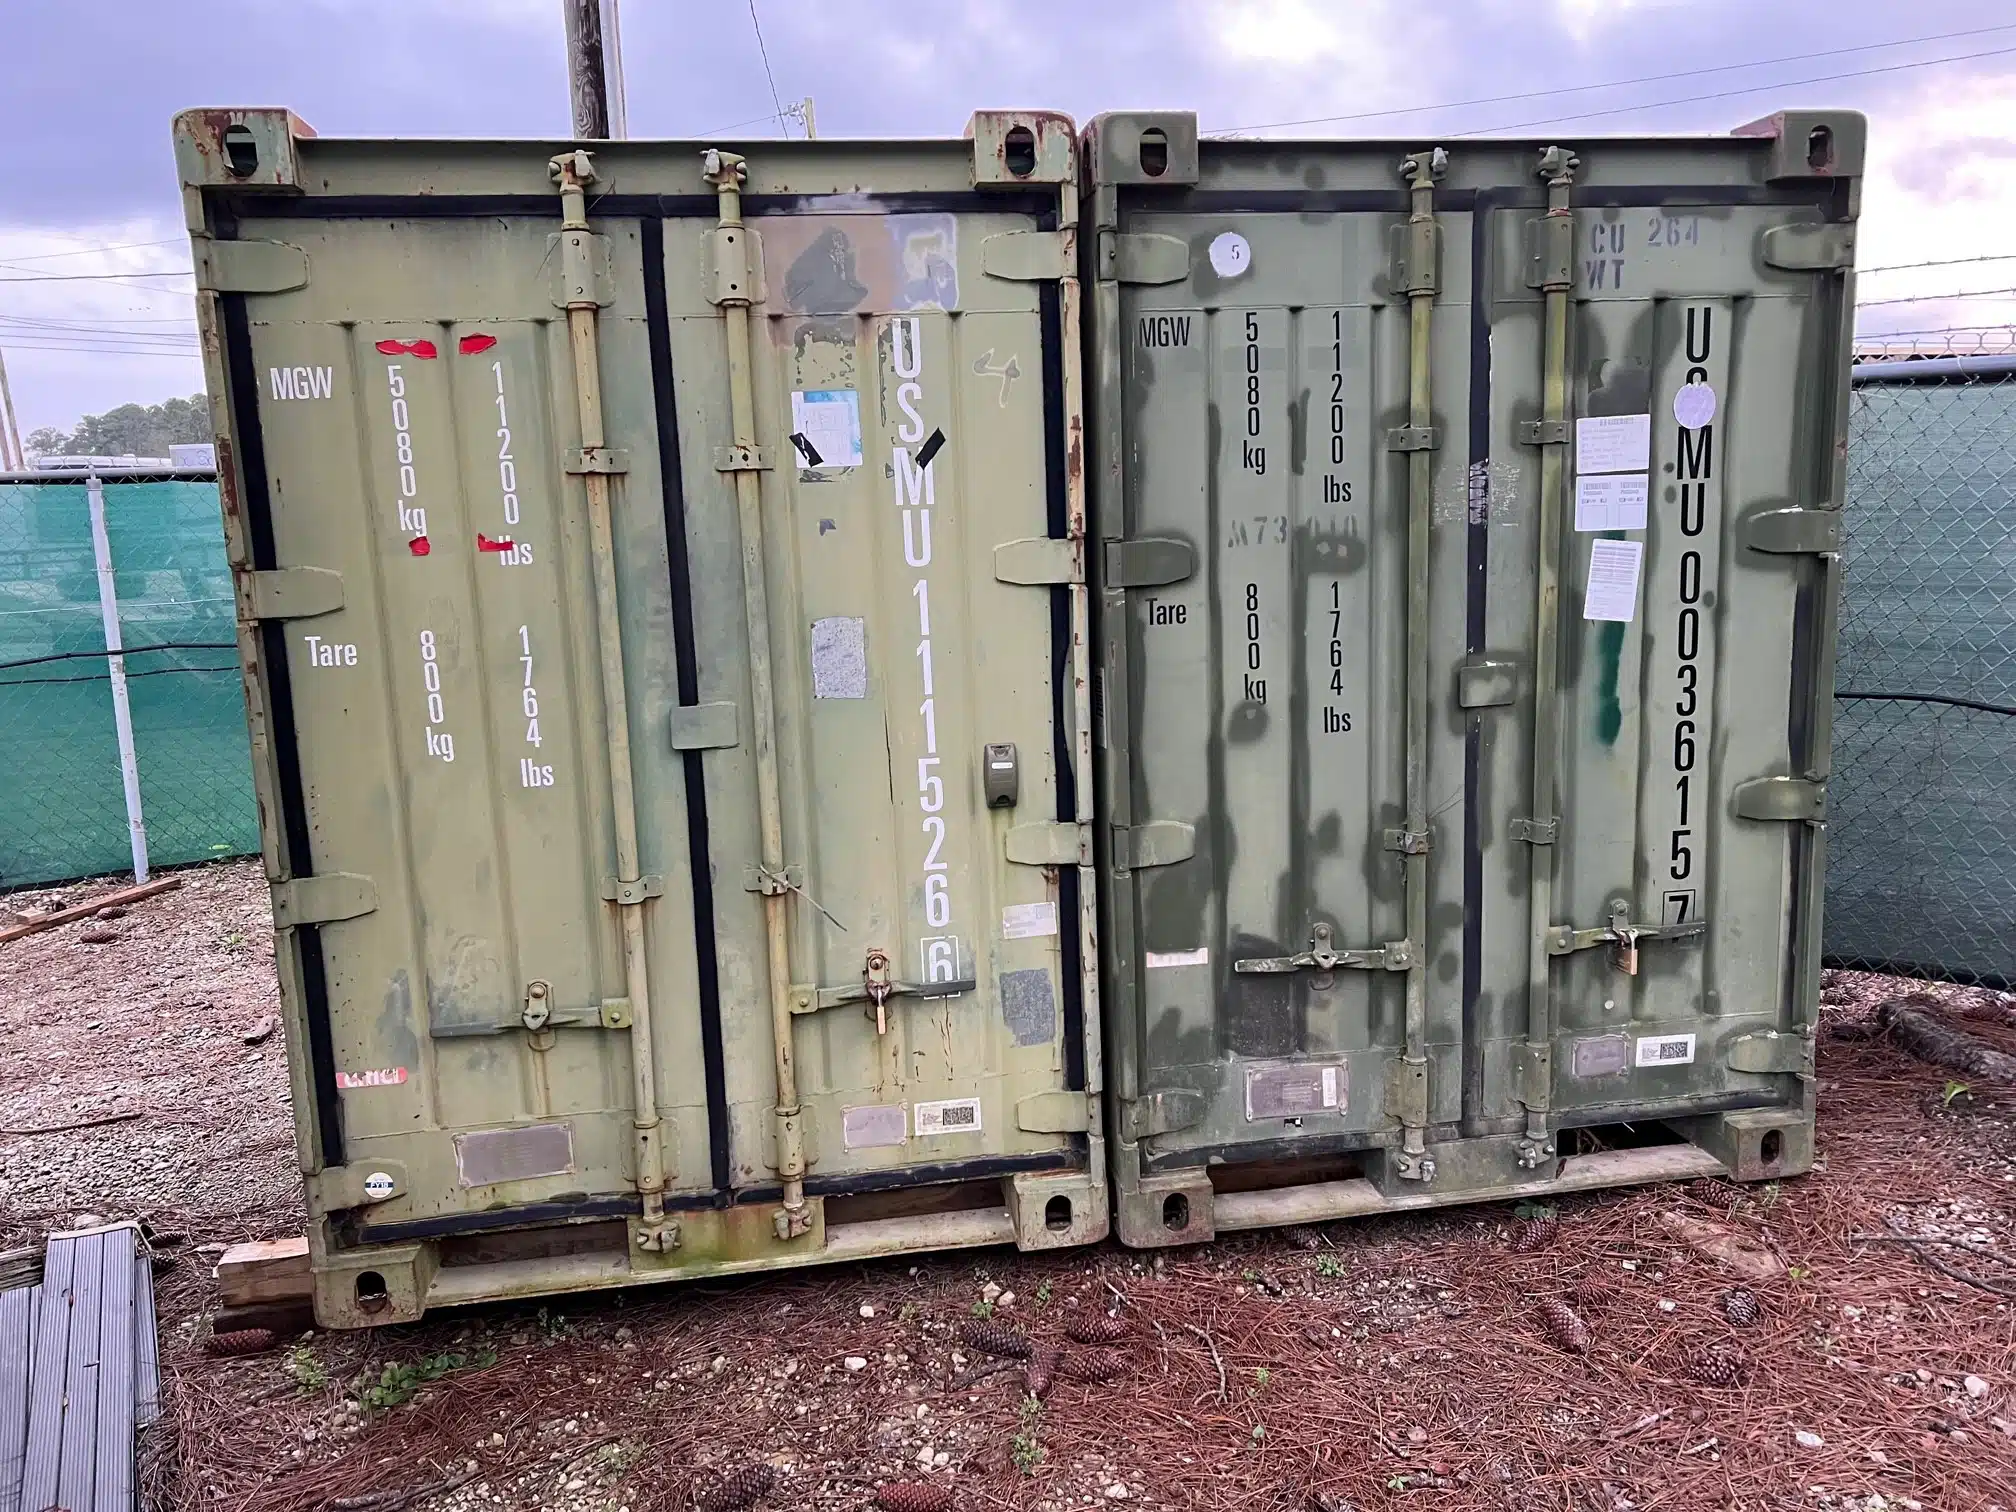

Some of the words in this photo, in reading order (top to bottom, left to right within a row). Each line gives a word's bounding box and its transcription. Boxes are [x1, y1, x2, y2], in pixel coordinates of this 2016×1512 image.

[1231, 244, 1240, 260] 5
[1591, 223, 1625, 254] CU
[1647, 217, 1699, 247] 264
[1585, 259, 1625, 290] WT
[1139, 316, 1190, 348] MGW
[269, 366, 333, 400] MGW
[1245, 311, 1260, 437] 5080
[1331, 310, 1344, 465] 11200
[387, 364, 417, 497] 5080
[491, 361, 520, 525] 11200
[1243, 439, 1266, 476] kg
[1324, 474, 1352, 504] lbs
[397, 499, 428, 538] kg
[498, 535, 534, 566] lbs
[1147, 597, 1188, 626] Tare
[1246, 583, 1261, 670] 800
[304, 636, 359, 667] Tare
[1329, 580, 1344, 696] 1764
[420, 630, 444, 724] 800
[518, 624, 543, 748] 1764
[1244, 673, 1267, 707] kg
[1323, 706, 1352, 734] lbs
[425, 726, 455, 763] kg
[520, 758, 555, 788] lbs
